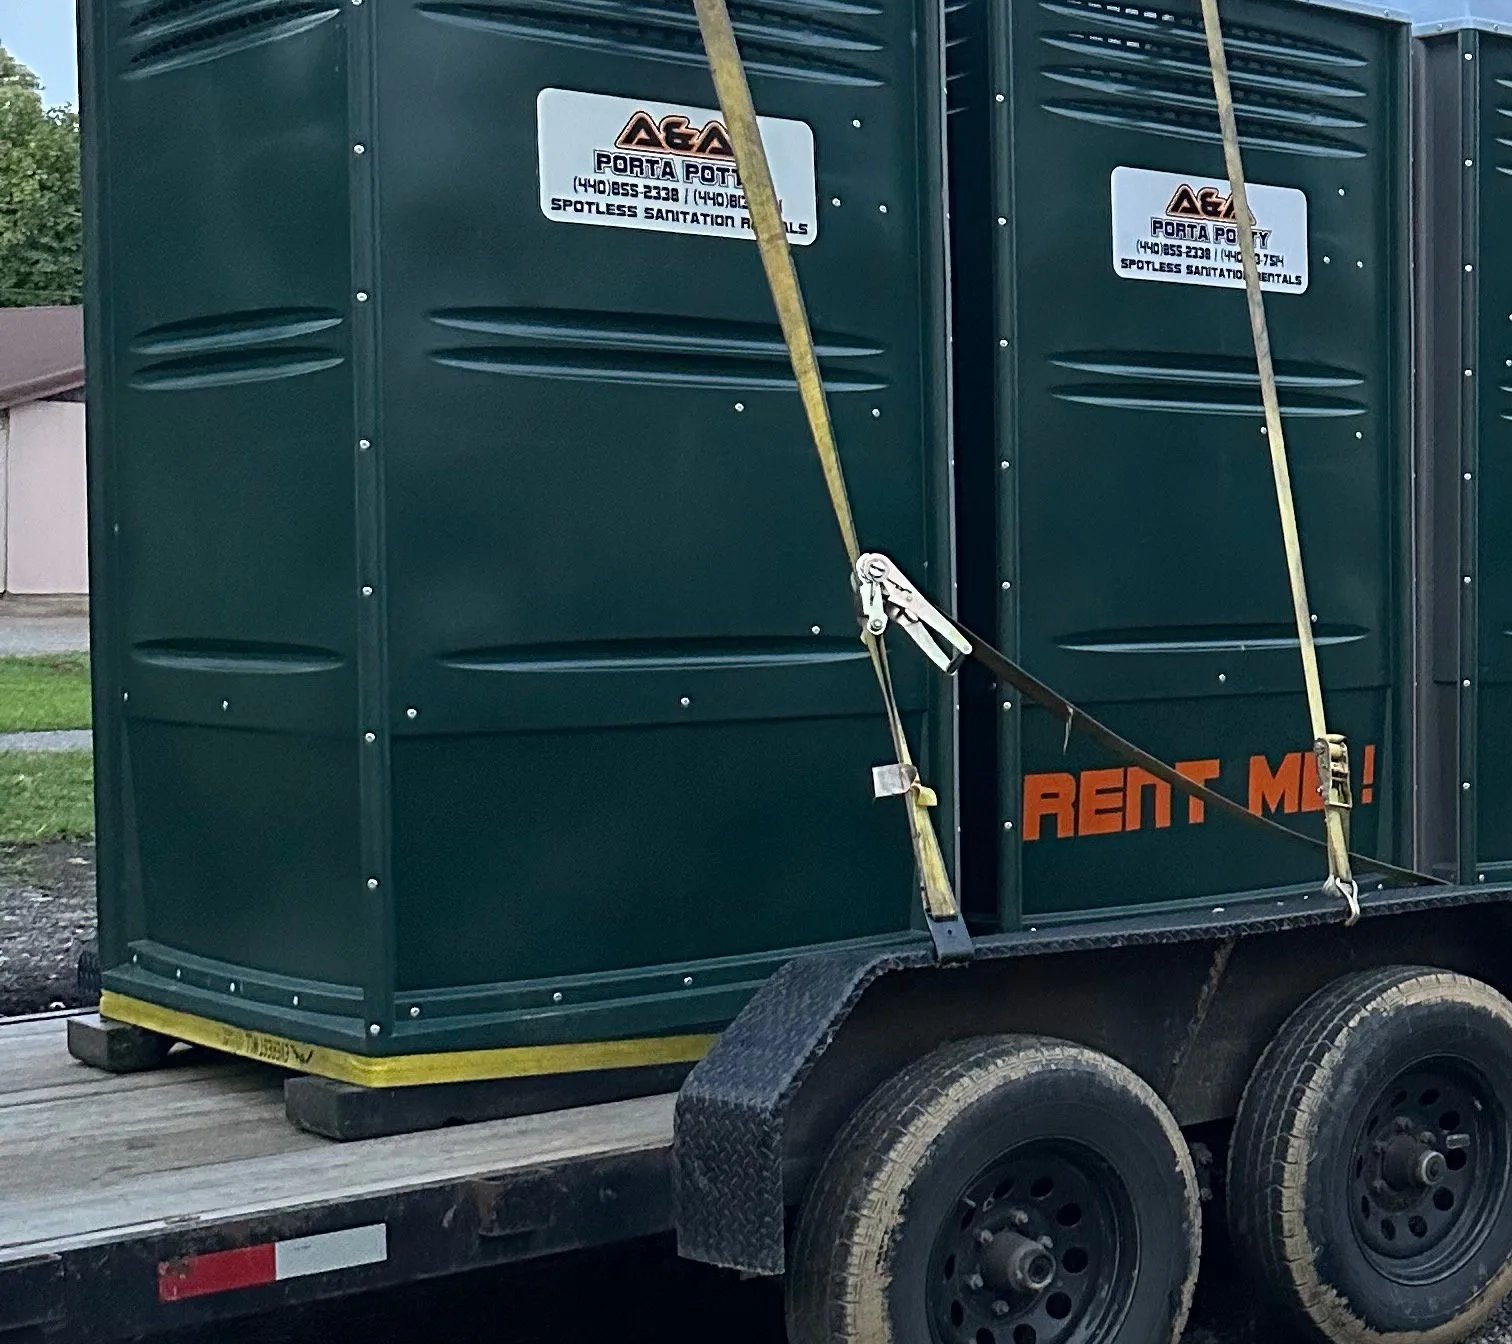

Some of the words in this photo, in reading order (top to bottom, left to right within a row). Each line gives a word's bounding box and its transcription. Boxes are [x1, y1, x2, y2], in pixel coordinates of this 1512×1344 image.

[615, 110, 737, 161] A&A
[593, 149, 679, 182] PORTA
[682, 159, 743, 189] POTT
[573, 175, 679, 202] (440)855-2338
[551, 197, 638, 218] SPOTLESS
[644, 206, 735, 229] SANITATION
[741, 217, 808, 236] RALS
[1150, 216, 1210, 244] PORTA
[1213, 224, 1272, 250] POTY
[1136, 238, 1211, 261] (440)855-2338
[1121, 257, 1182, 274] SPOTLESS
[1186, 265, 1244, 281] SANITATIO
[1023, 758, 1220, 842] RENT
